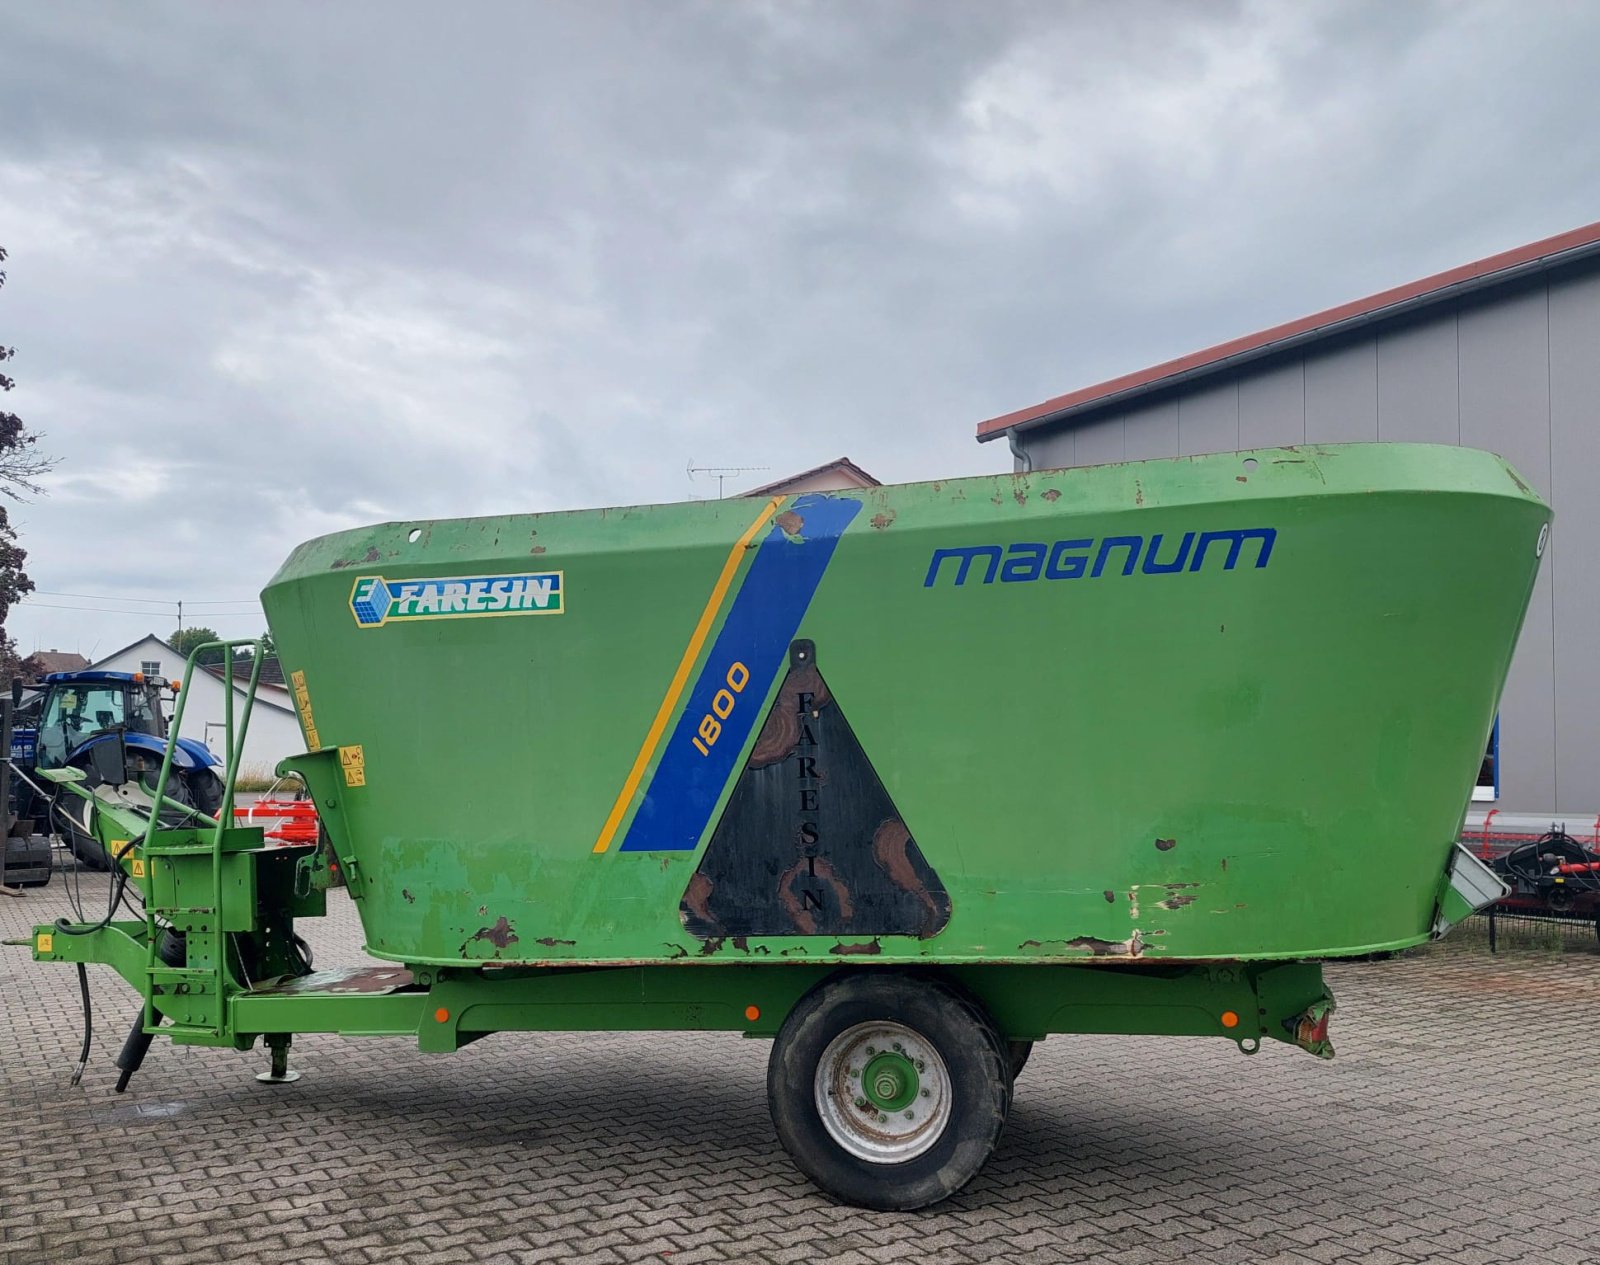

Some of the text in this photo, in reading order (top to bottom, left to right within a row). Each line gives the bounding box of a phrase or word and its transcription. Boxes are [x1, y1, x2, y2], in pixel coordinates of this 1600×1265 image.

[397, 578, 552, 614] FARESIN
[692, 661, 750, 757] 1800
[796, 692, 825, 911] FARESIN
